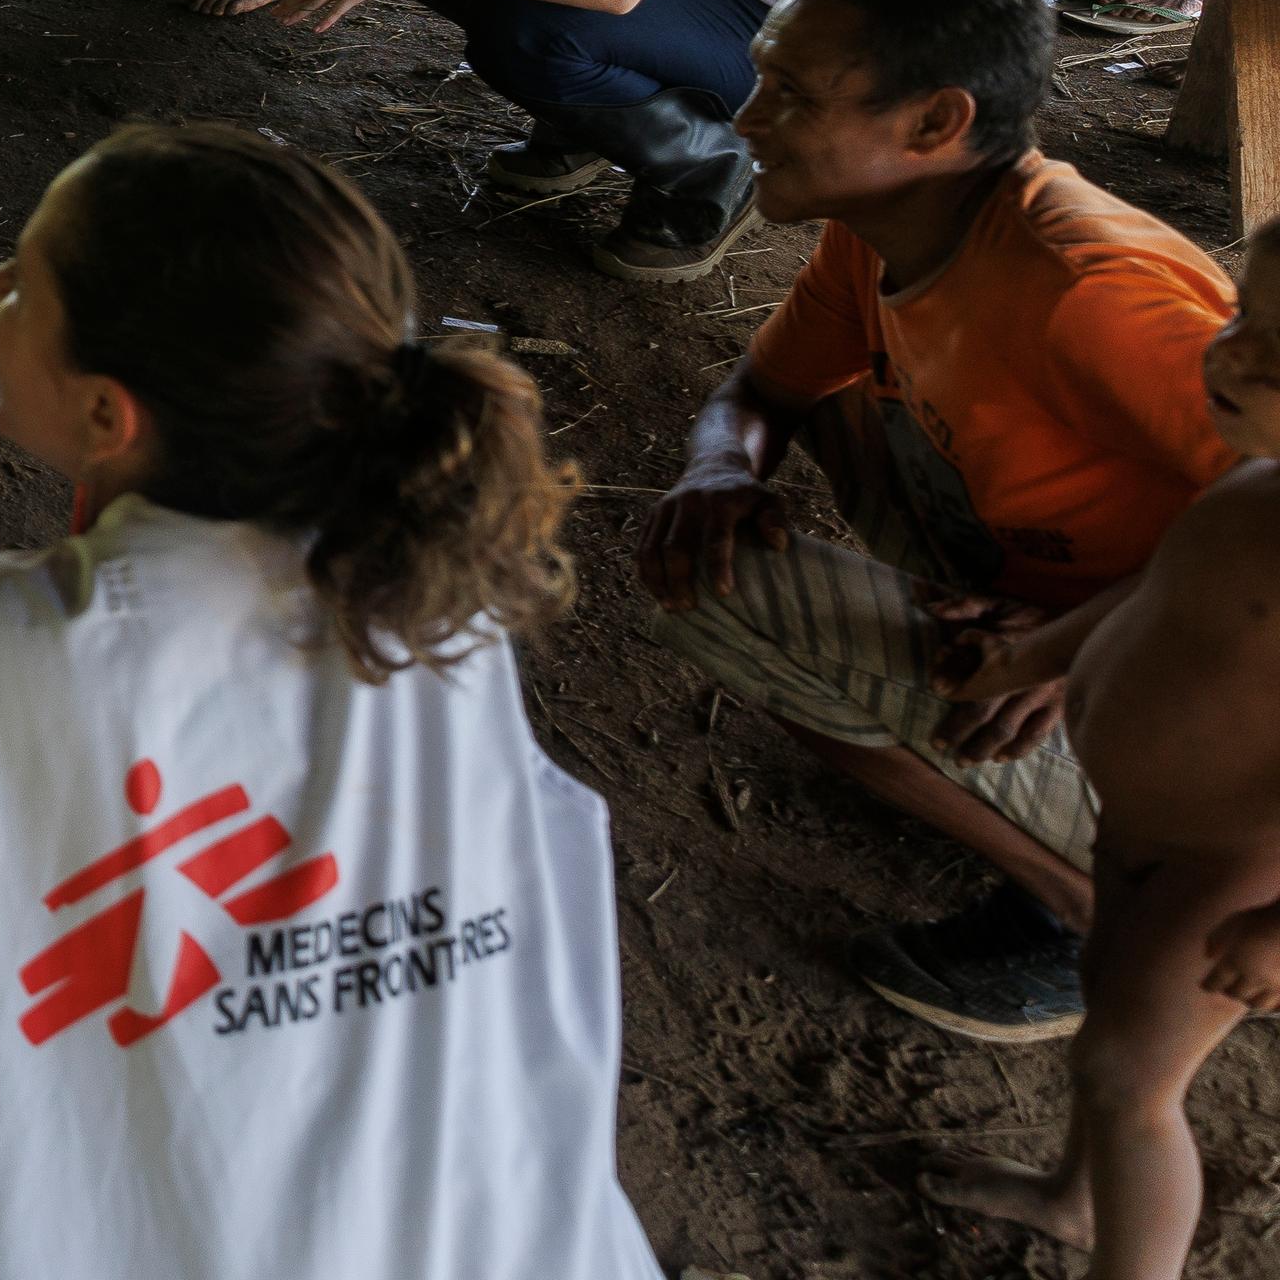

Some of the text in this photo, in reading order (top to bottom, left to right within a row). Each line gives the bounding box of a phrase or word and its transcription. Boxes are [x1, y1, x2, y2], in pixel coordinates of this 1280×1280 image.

[213, 908, 510, 1036] SANS FRONTRES
[246, 887, 444, 978] MEDECINS
